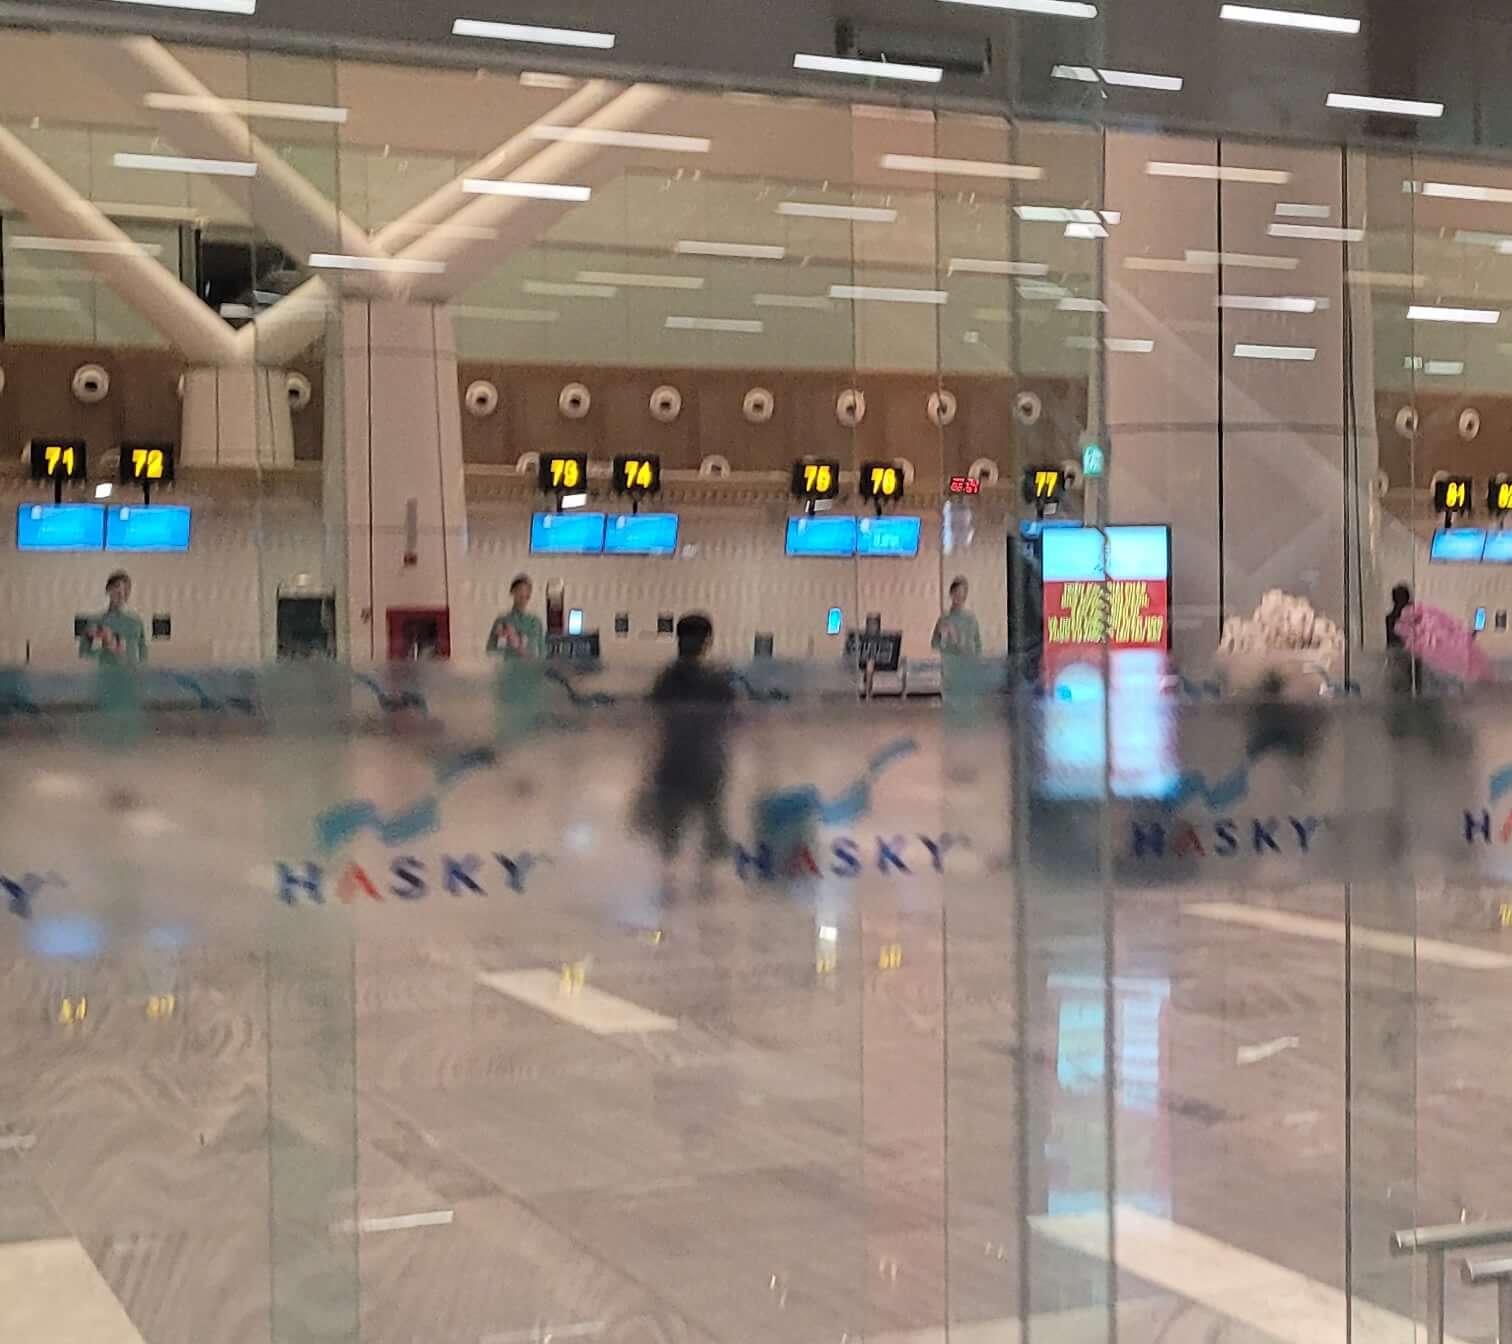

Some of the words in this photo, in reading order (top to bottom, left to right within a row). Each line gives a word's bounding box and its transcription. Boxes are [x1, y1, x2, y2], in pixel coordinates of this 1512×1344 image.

[45, 446, 74, 476] 71
[132, 449, 163, 478] 72
[624, 460, 653, 489] 74
[1035, 471, 1058, 497] 77
[1131, 814, 1317, 857] HASKY
[735, 832, 952, 880] HASKY
[274, 850, 536, 906] HASKY
